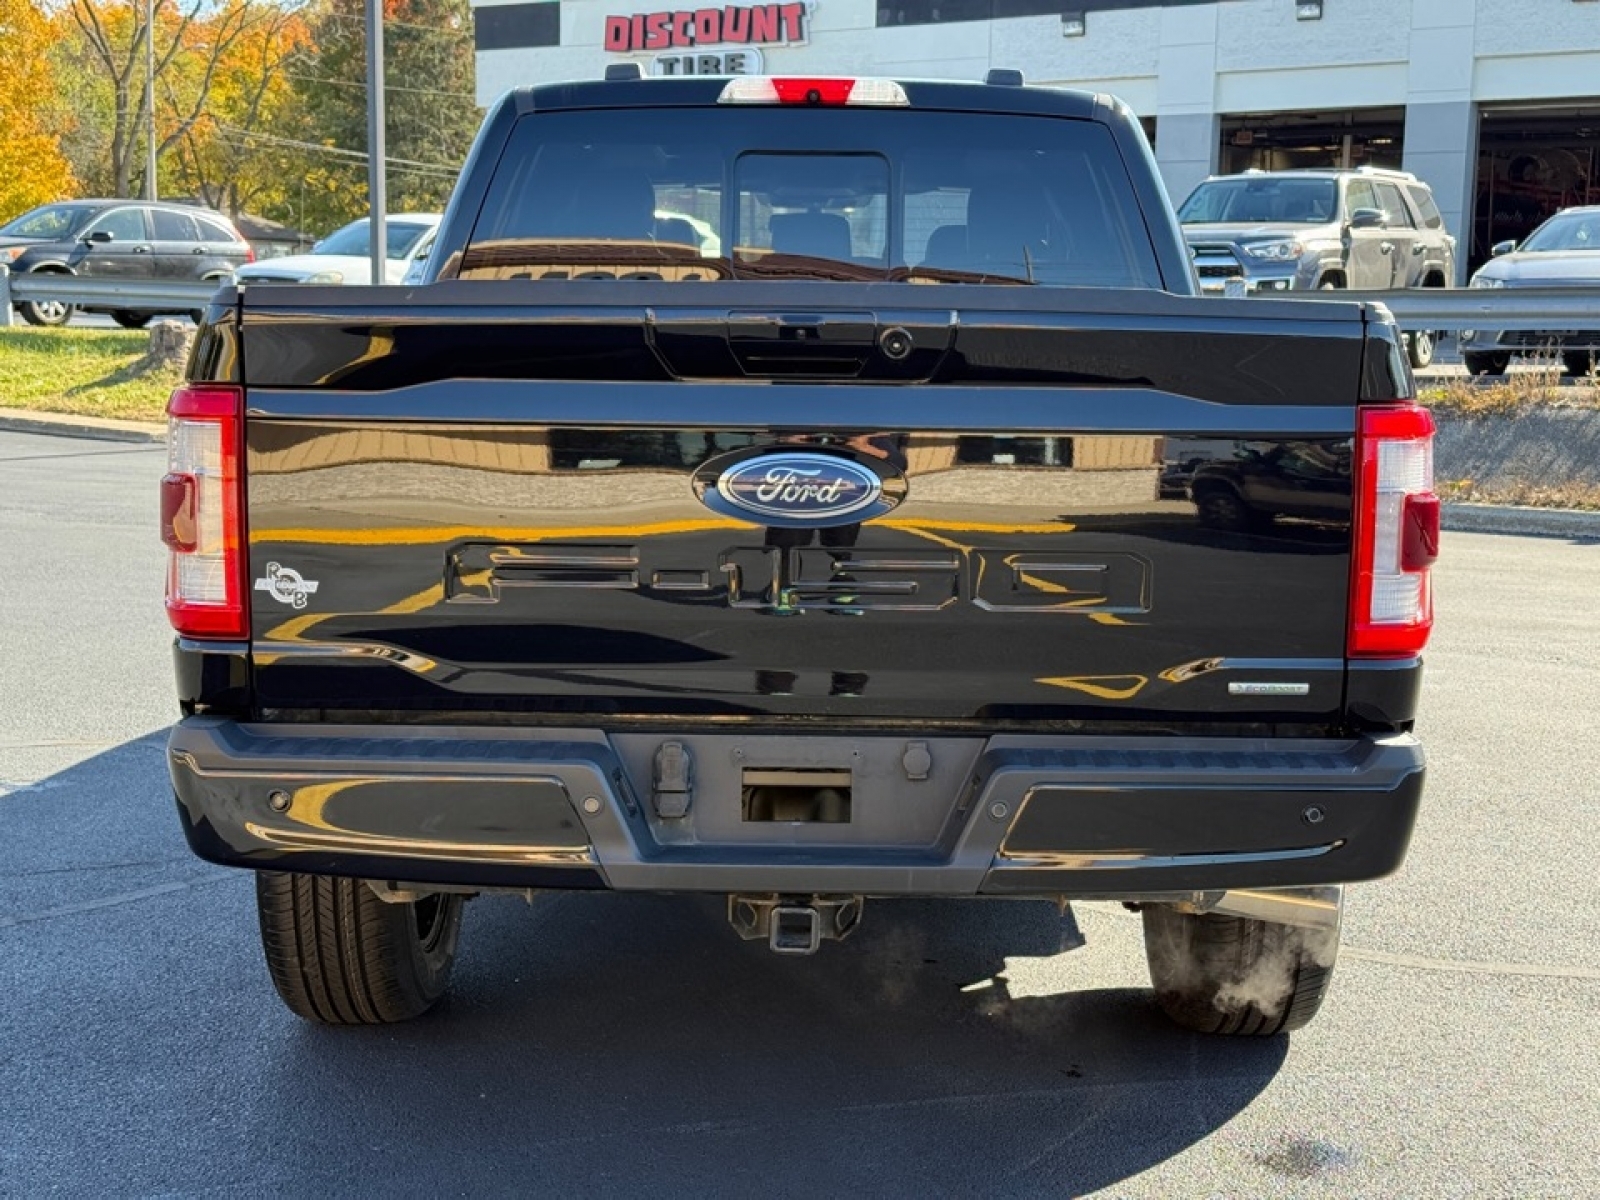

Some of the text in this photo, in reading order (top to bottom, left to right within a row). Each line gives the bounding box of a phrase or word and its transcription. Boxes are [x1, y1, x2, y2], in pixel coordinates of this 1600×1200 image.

[604, 2, 806, 52] DISCOUNT
[657, 53, 747, 75] TIRE
[756, 466, 844, 503] Ford
[443, 541, 1152, 613] F-150
